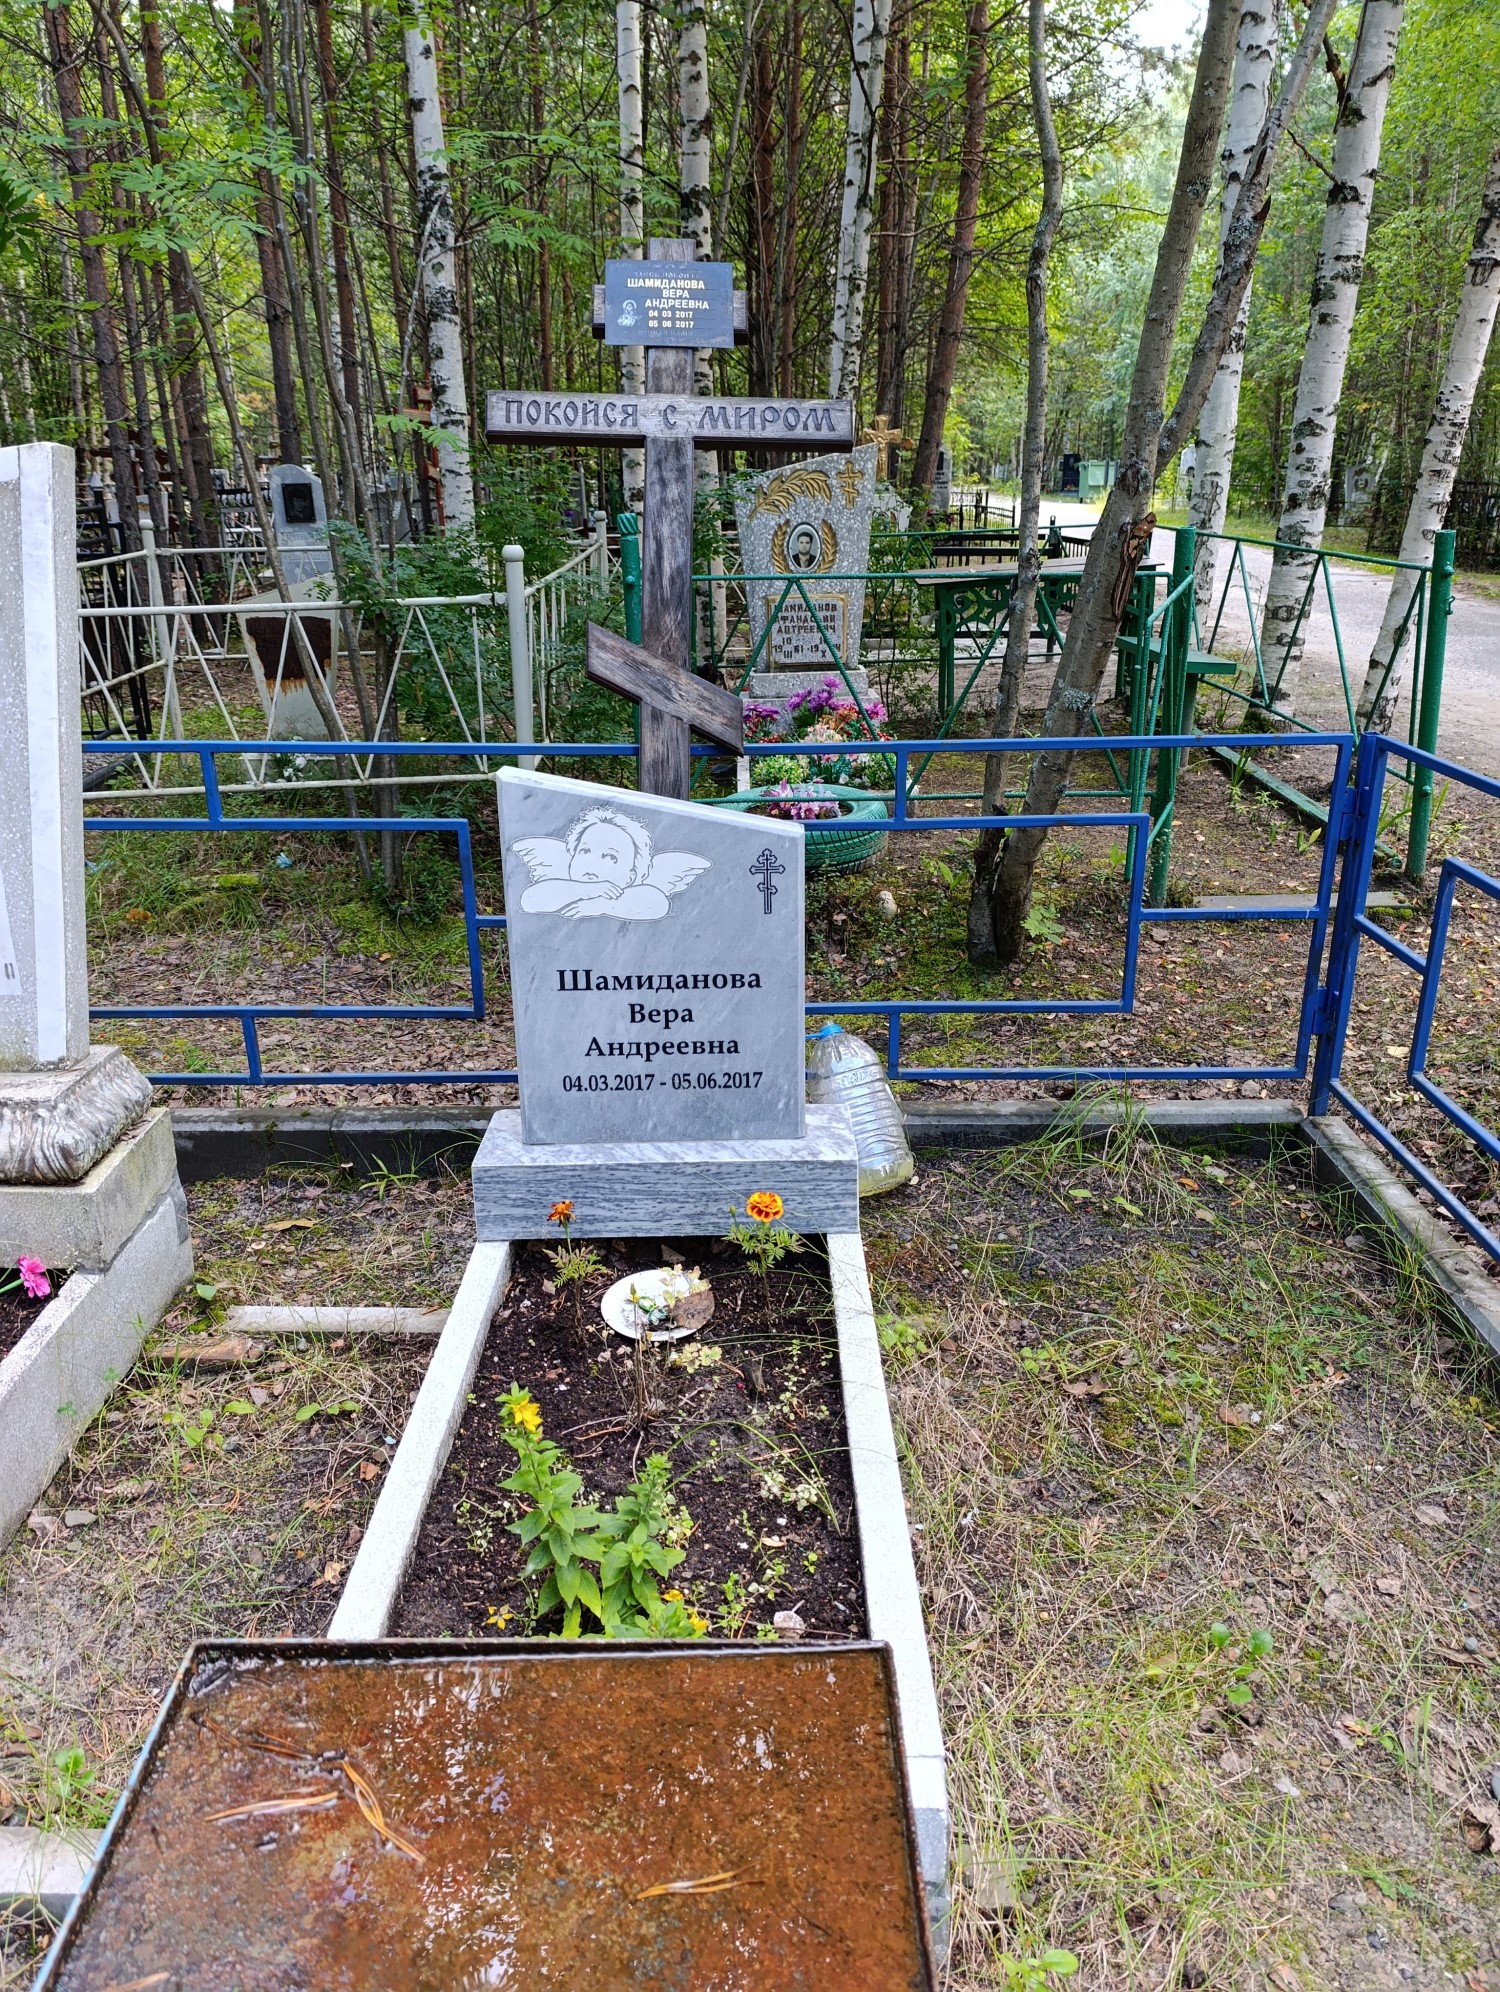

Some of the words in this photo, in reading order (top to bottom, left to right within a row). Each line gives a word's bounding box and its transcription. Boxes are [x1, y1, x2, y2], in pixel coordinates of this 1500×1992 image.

[627, 278, 705, 289] ШАМИДАНОВА
[662, 289, 690, 299] ВЕРА
[644, 298, 710, 310] АНДРЕЕВНА
[648, 310, 658, 318] 04
[662, 310, 672, 318] 03
[675, 310, 694, 319] 2017
[648, 320, 658, 328] 05
[675, 320, 694, 329] 2017
[504, 399, 639, 428] ПОКОЙСЯ
[662, 404, 678, 431] С
[699, 405, 837, 433] МИРОМ
[556, 969, 762, 993] Шамиданова
[628, 1003, 694, 1030] Вера
[584, 1036, 740, 1062] Андреевна
[562, 1073, 655, 1092] 04.03.2017
[671, 1071, 763, 1090] 05.06.2017
